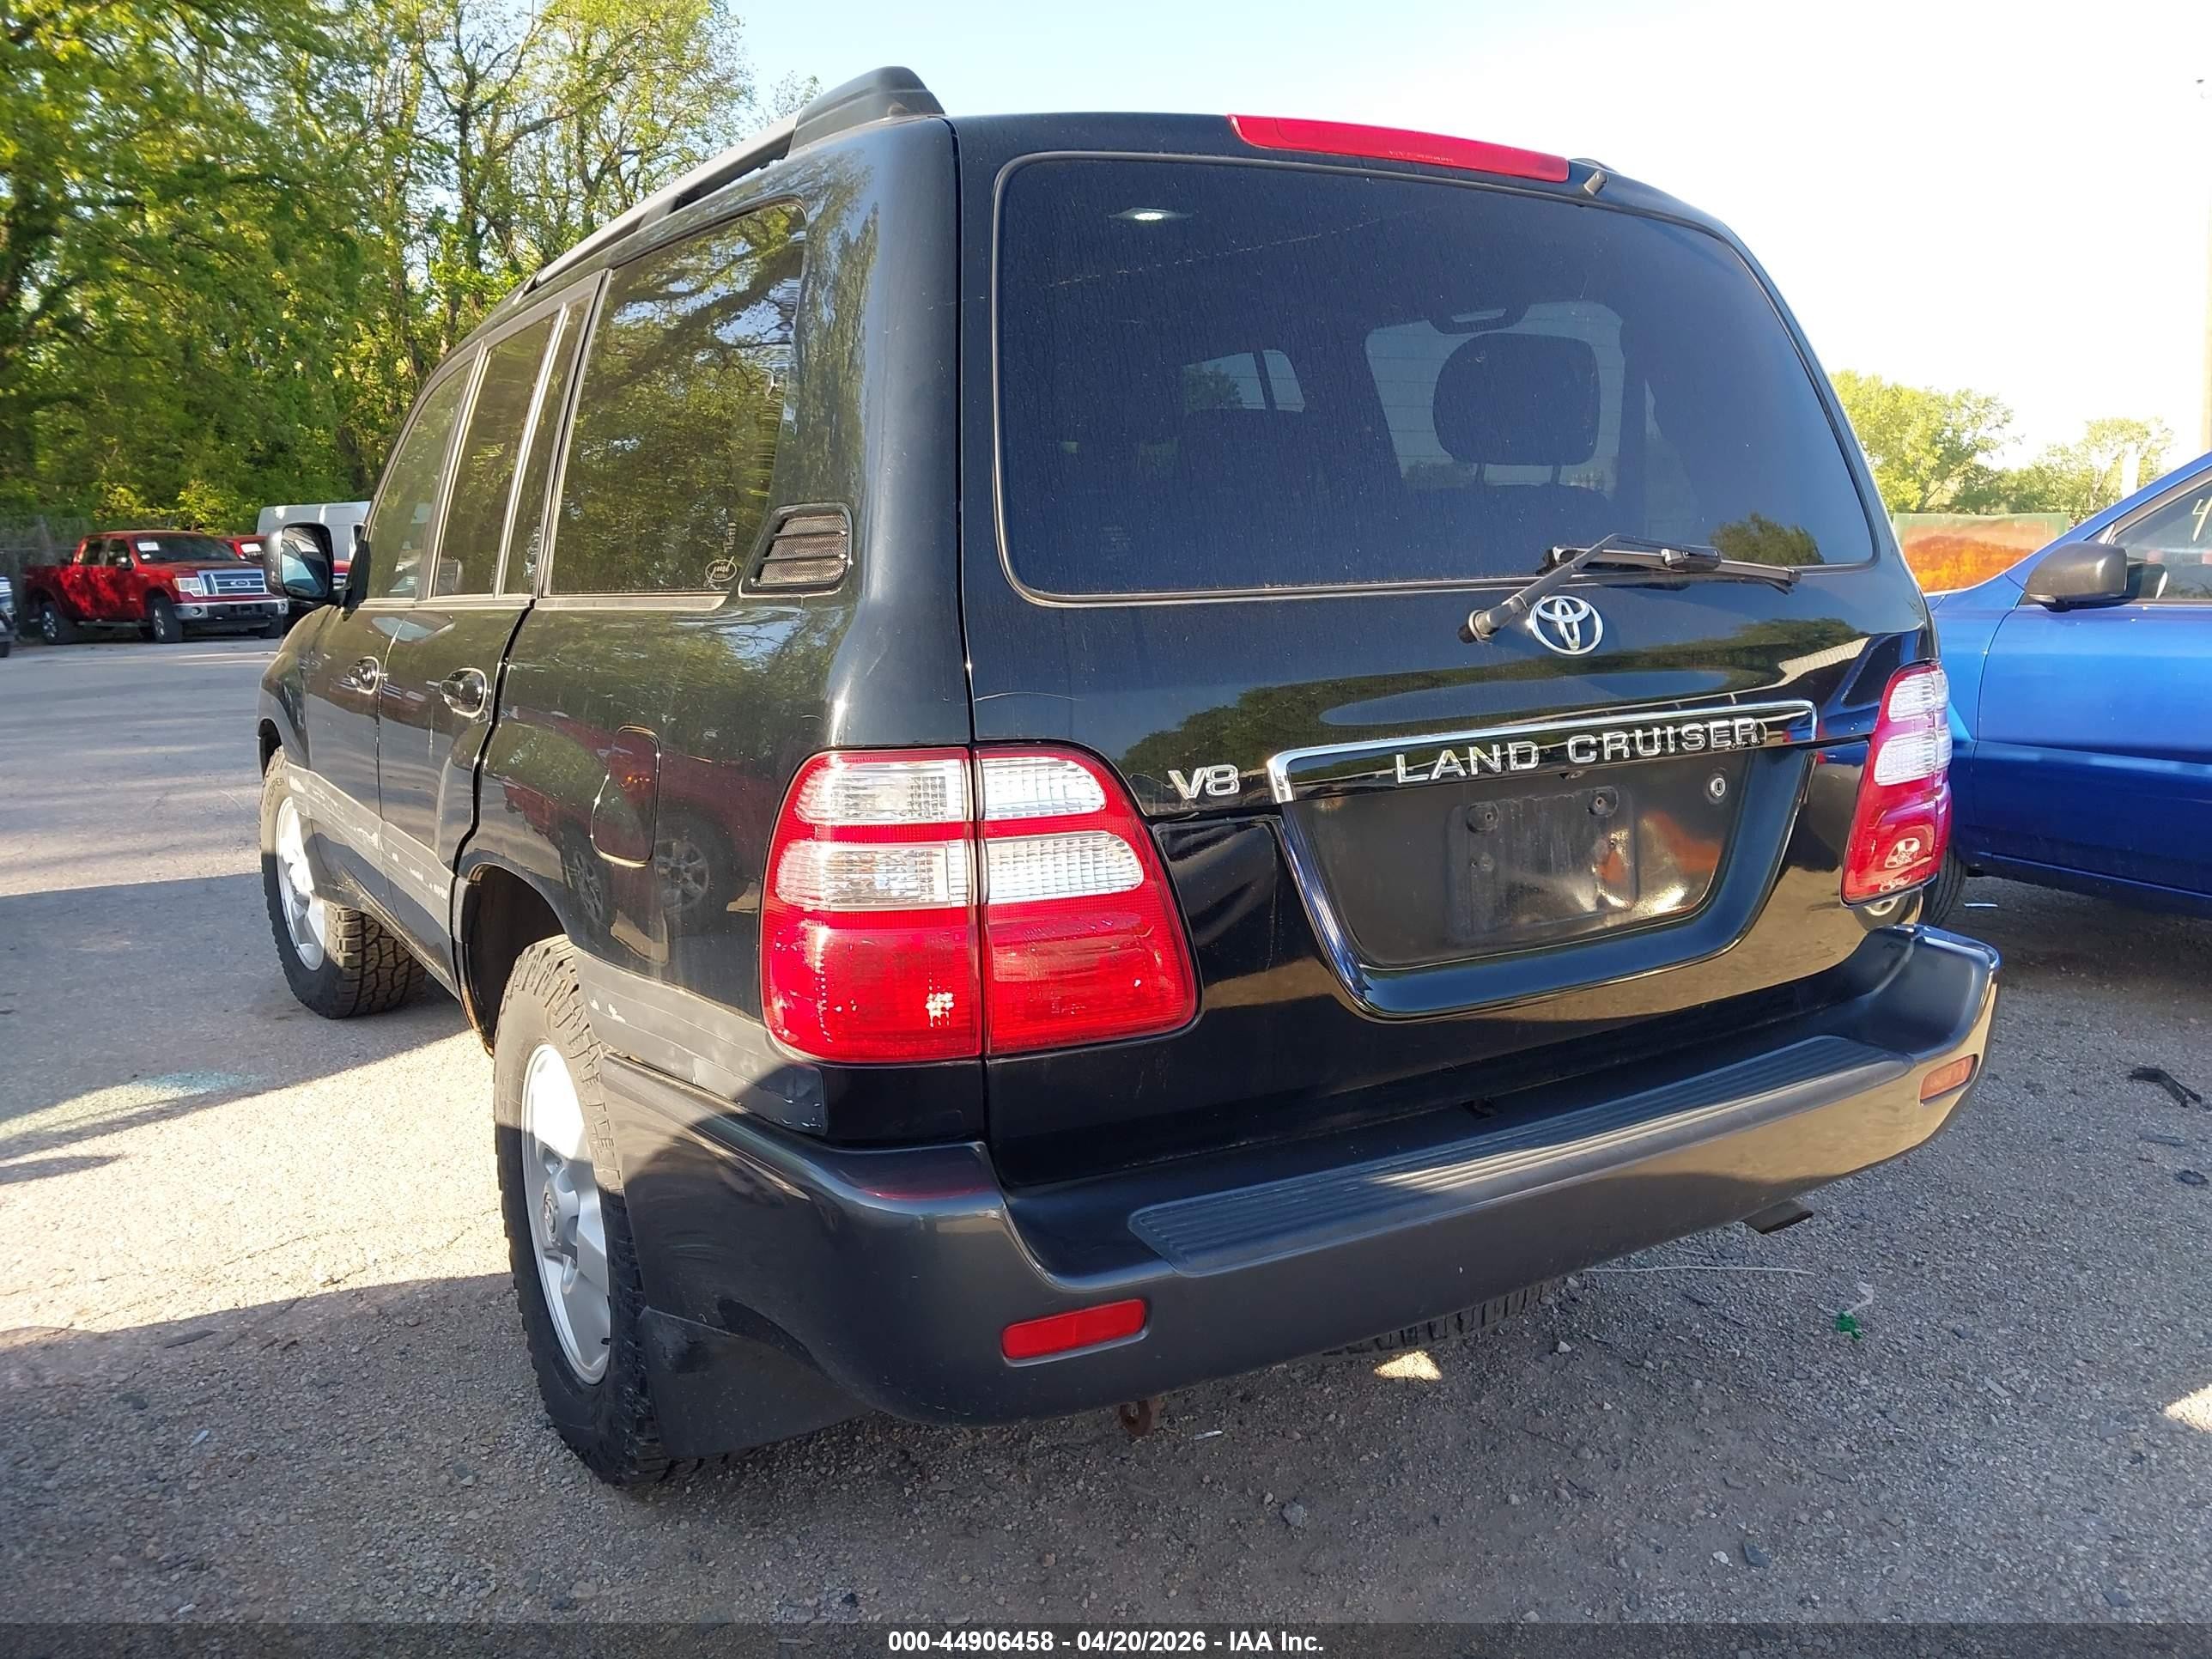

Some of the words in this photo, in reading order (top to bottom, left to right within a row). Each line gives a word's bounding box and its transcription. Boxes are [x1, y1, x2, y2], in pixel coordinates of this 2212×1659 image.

[1395, 739, 1540, 784] LAND
[1567, 717, 1759, 764] CRUISER
[1167, 764, 1240, 799] V8
